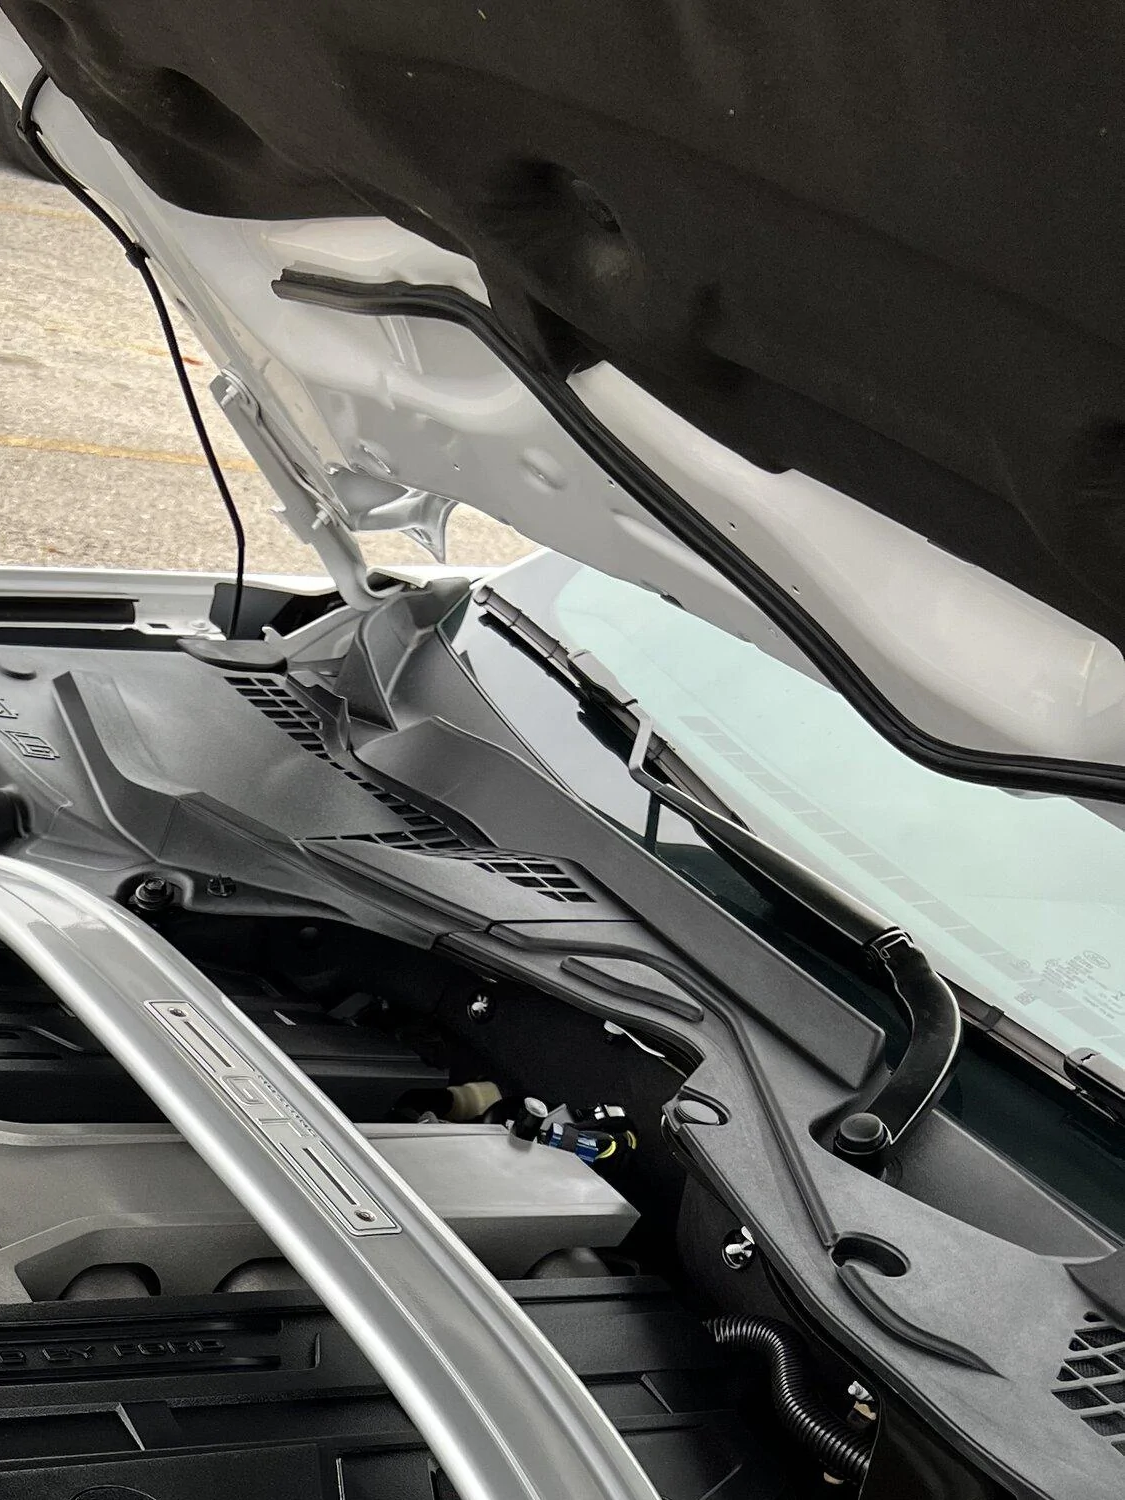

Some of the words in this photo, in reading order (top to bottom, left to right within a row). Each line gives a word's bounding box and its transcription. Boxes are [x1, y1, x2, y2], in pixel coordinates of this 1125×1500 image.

[221, 1075, 305, 1138] GT
[41, 1343, 94, 1362] BY
[111, 1336, 226, 1359] FORD
